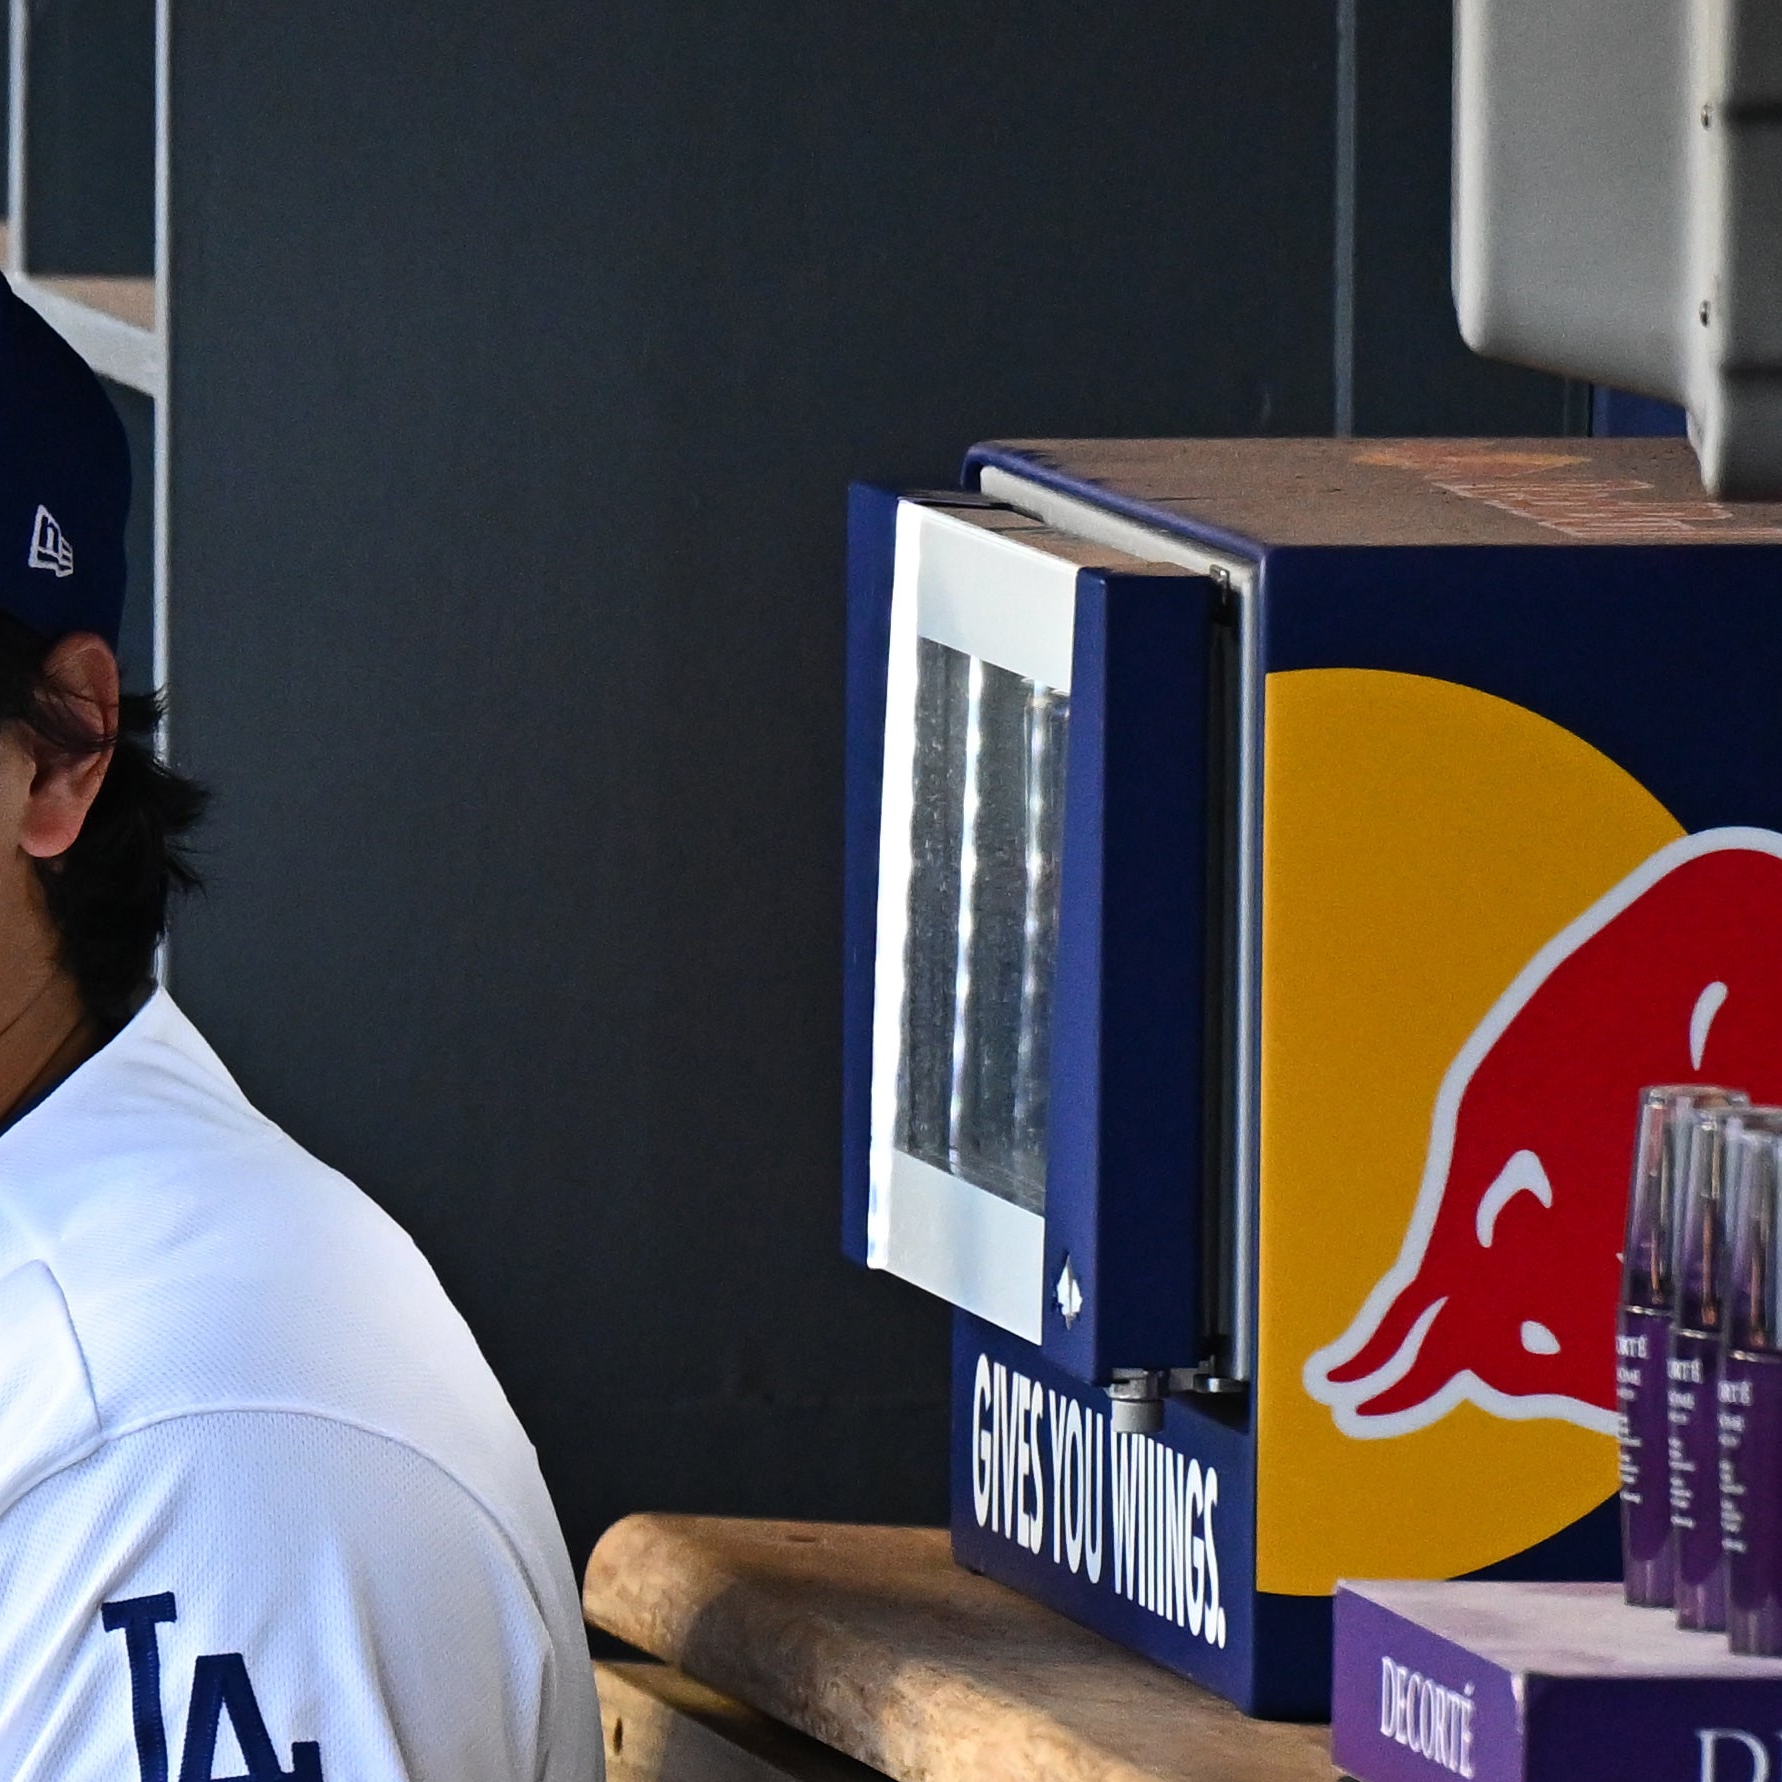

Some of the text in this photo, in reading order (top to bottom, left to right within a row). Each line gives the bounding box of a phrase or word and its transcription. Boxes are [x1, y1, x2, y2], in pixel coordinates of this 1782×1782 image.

[972, 1353, 1044, 1555] GIVES
[1049, 1389, 1103, 1584] YOU
[1380, 1656, 1475, 1780] DECORTÉ
